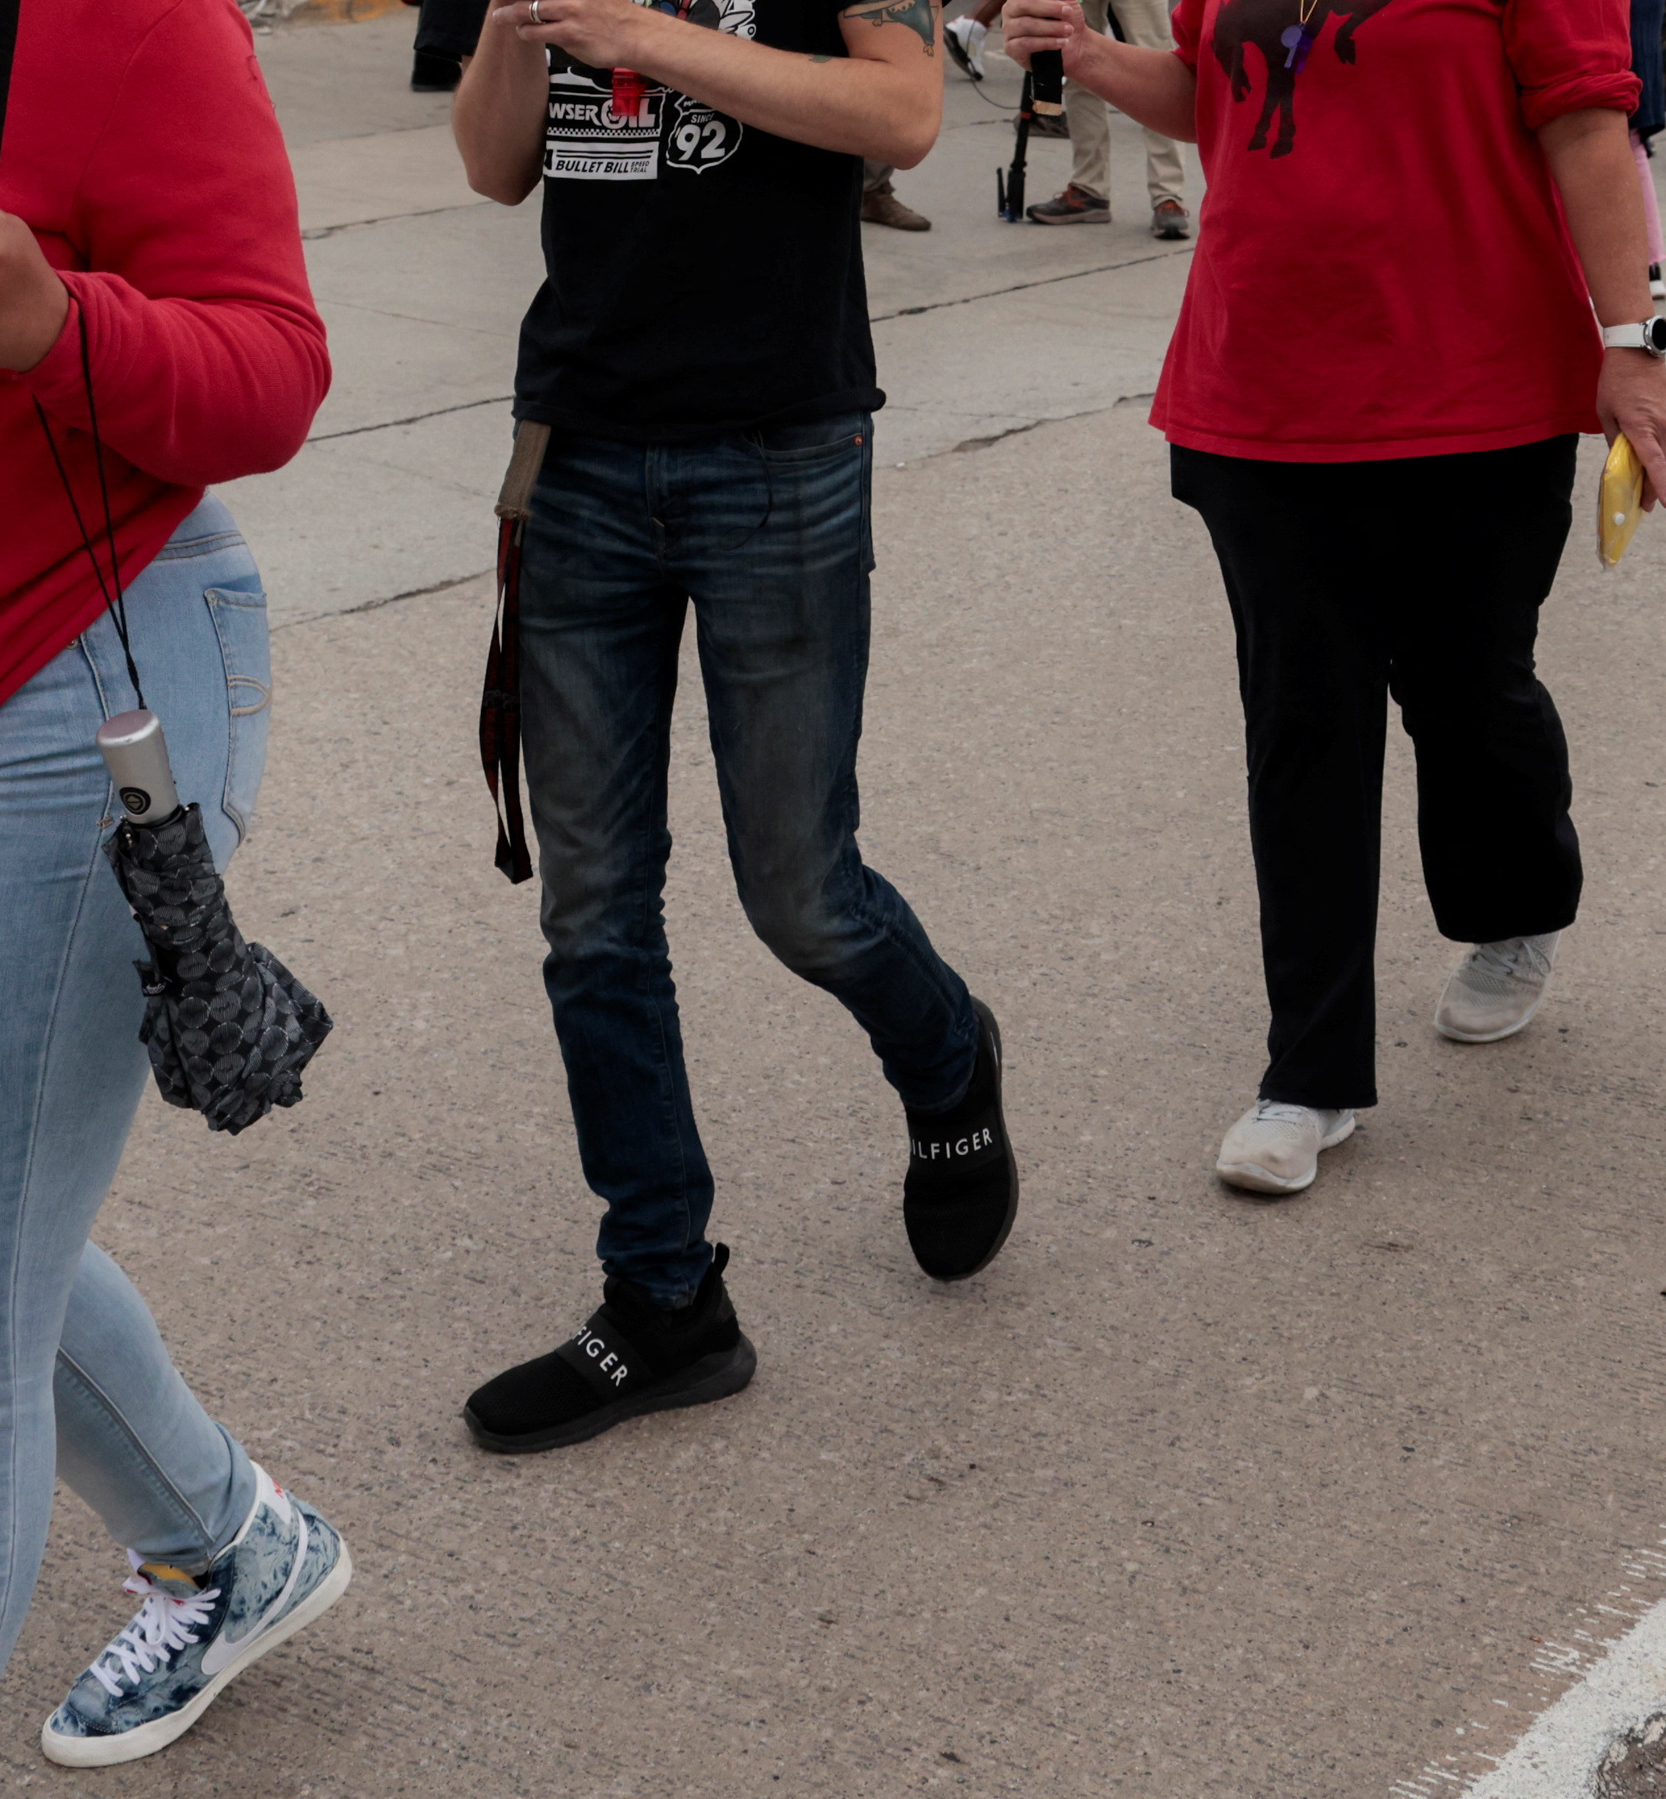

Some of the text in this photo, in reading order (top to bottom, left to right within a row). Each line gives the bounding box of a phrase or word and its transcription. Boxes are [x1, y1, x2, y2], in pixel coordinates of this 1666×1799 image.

[601, 98, 656, 130] OIL
[675, 120, 727, 161] '92
[556, 160, 629, 173] BULLET BILL
